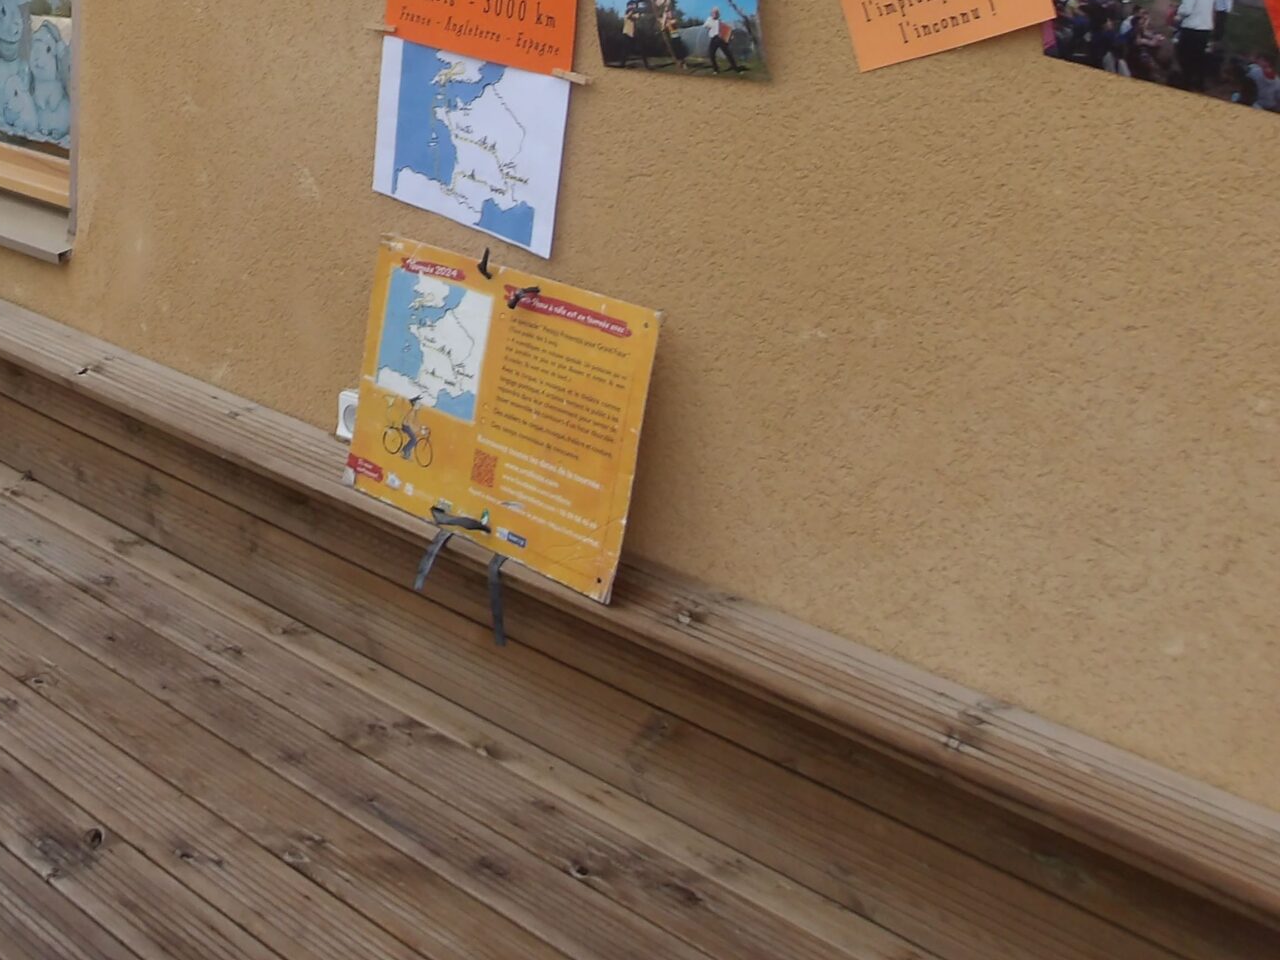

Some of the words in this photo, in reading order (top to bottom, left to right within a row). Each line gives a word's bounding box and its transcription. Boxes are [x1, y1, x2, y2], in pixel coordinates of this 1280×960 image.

[400, 6, 431, 26] France
[445, 16, 501, 42] Angleterre
[516, 32, 559, 55] Espagne
[535, 1, 556, 28] km
[898, 8, 981, 44] l'inconnu
